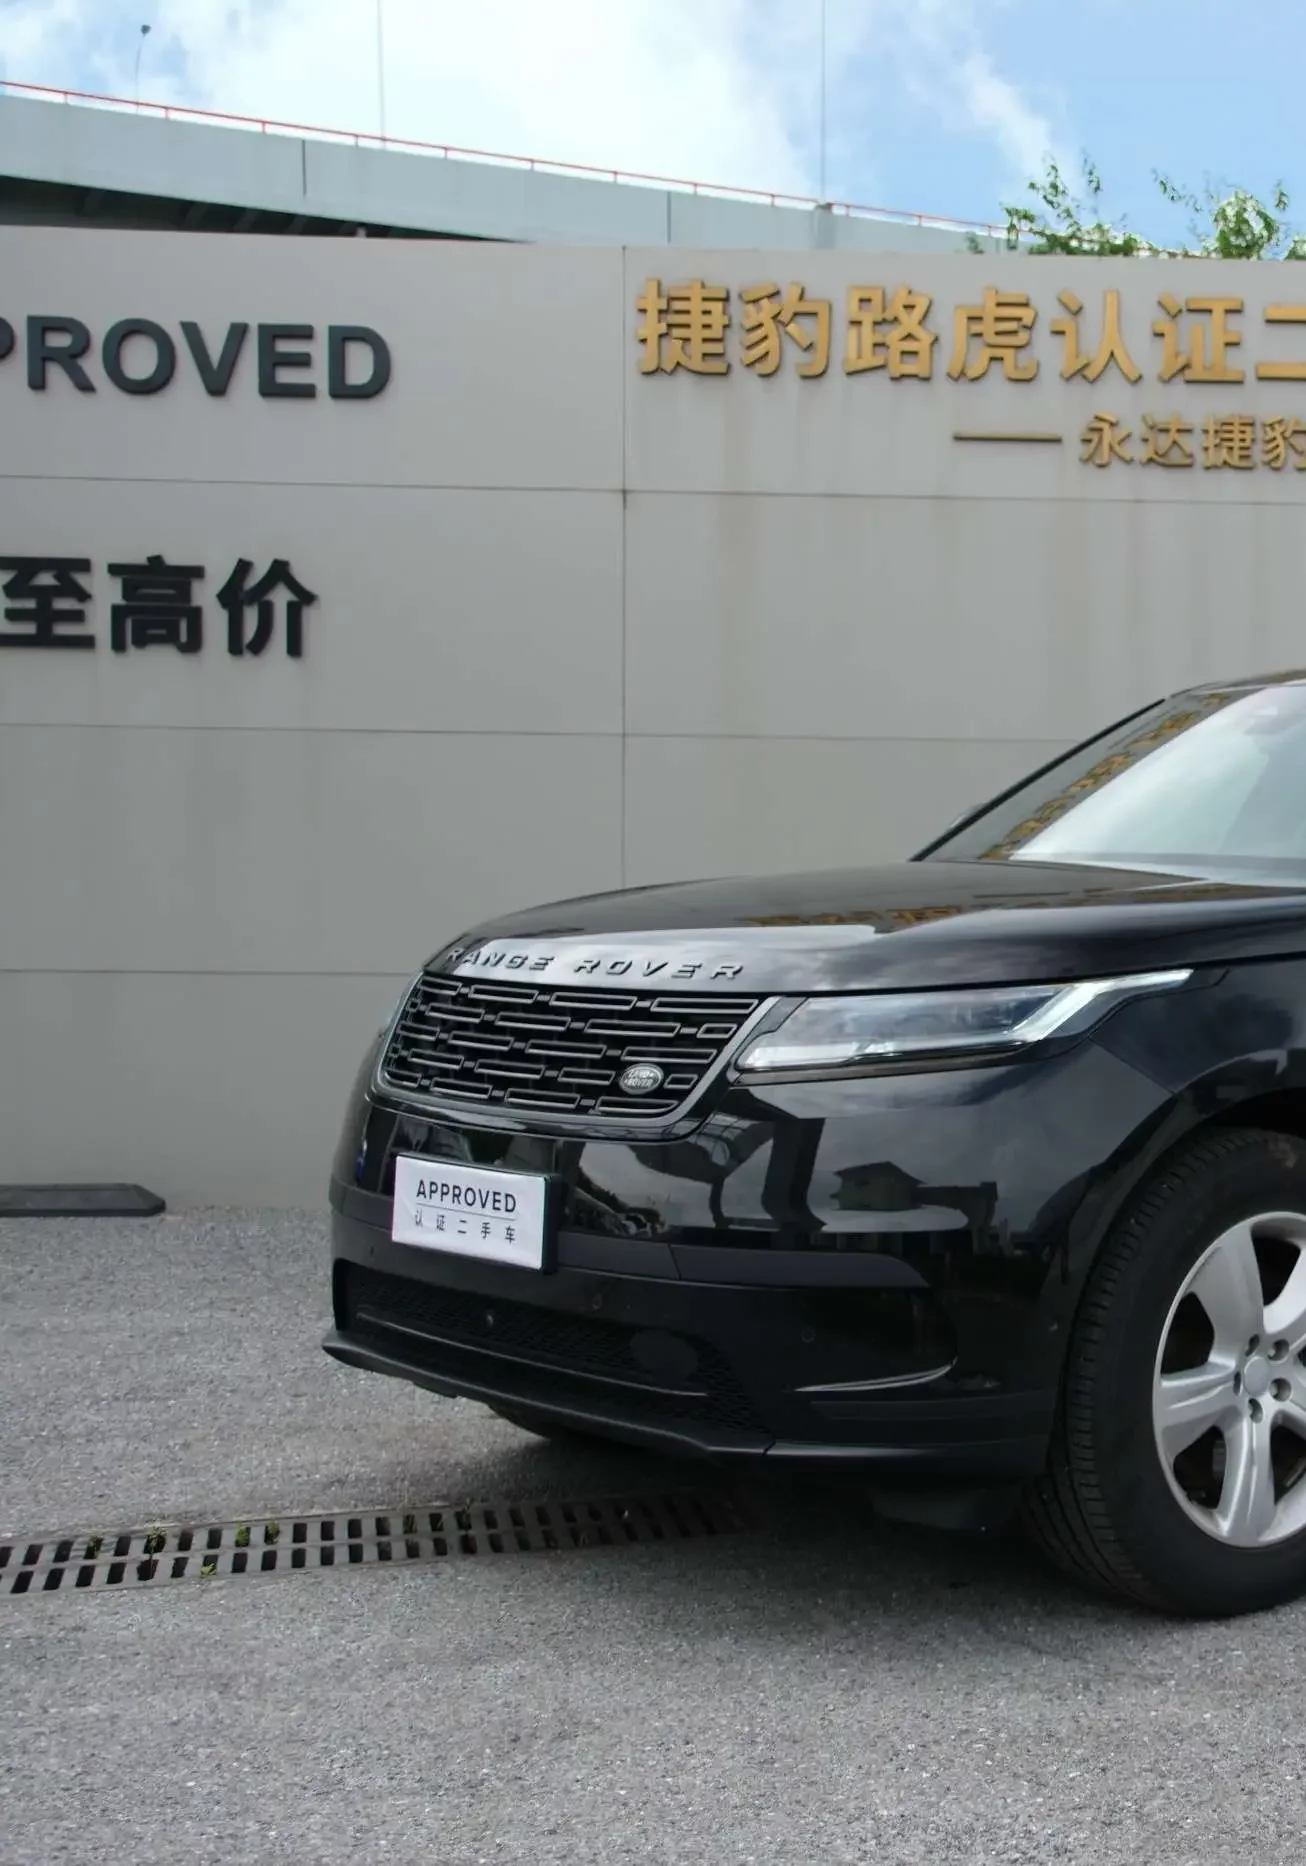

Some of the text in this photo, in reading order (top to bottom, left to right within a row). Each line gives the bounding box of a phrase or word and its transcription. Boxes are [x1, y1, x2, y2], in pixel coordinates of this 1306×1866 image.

[0, 315, 392, 400] ROVED
[0, 554, 319, 657] 至高价
[446, 947, 743, 981] RANGE ROVER
[416, 1179, 517, 1213] APPROVED
[414, 1210, 516, 1245] 认证二手车
